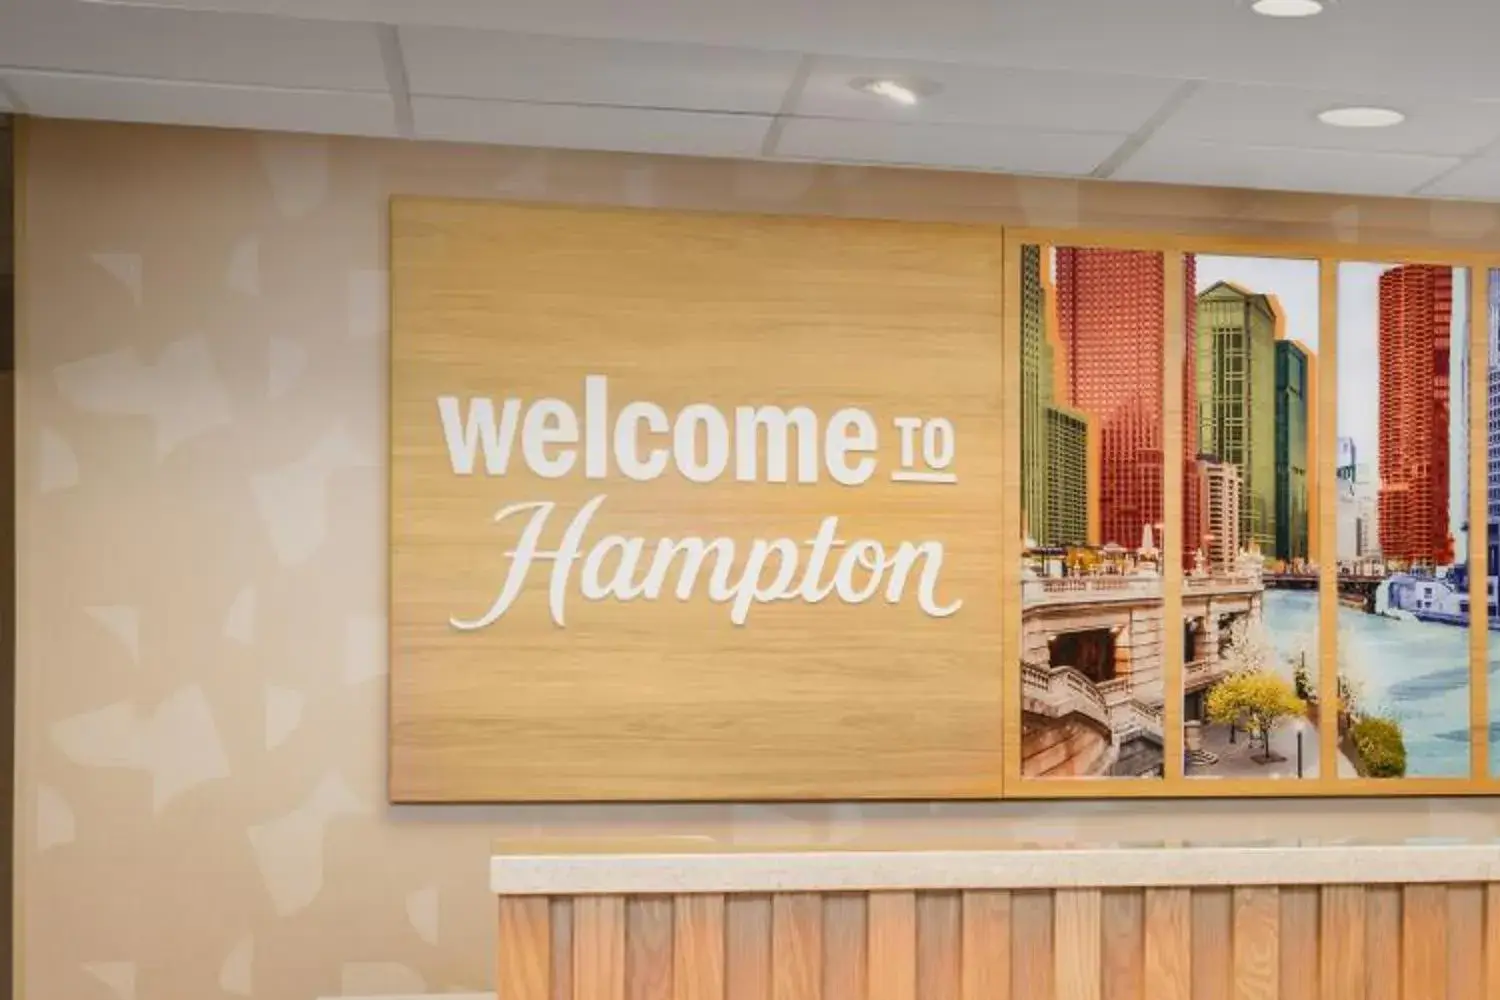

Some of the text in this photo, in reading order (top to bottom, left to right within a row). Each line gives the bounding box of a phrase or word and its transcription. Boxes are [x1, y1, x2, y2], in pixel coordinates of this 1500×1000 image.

[437, 375, 955, 485] welcome TO
[449, 494, 963, 630] Hampton
